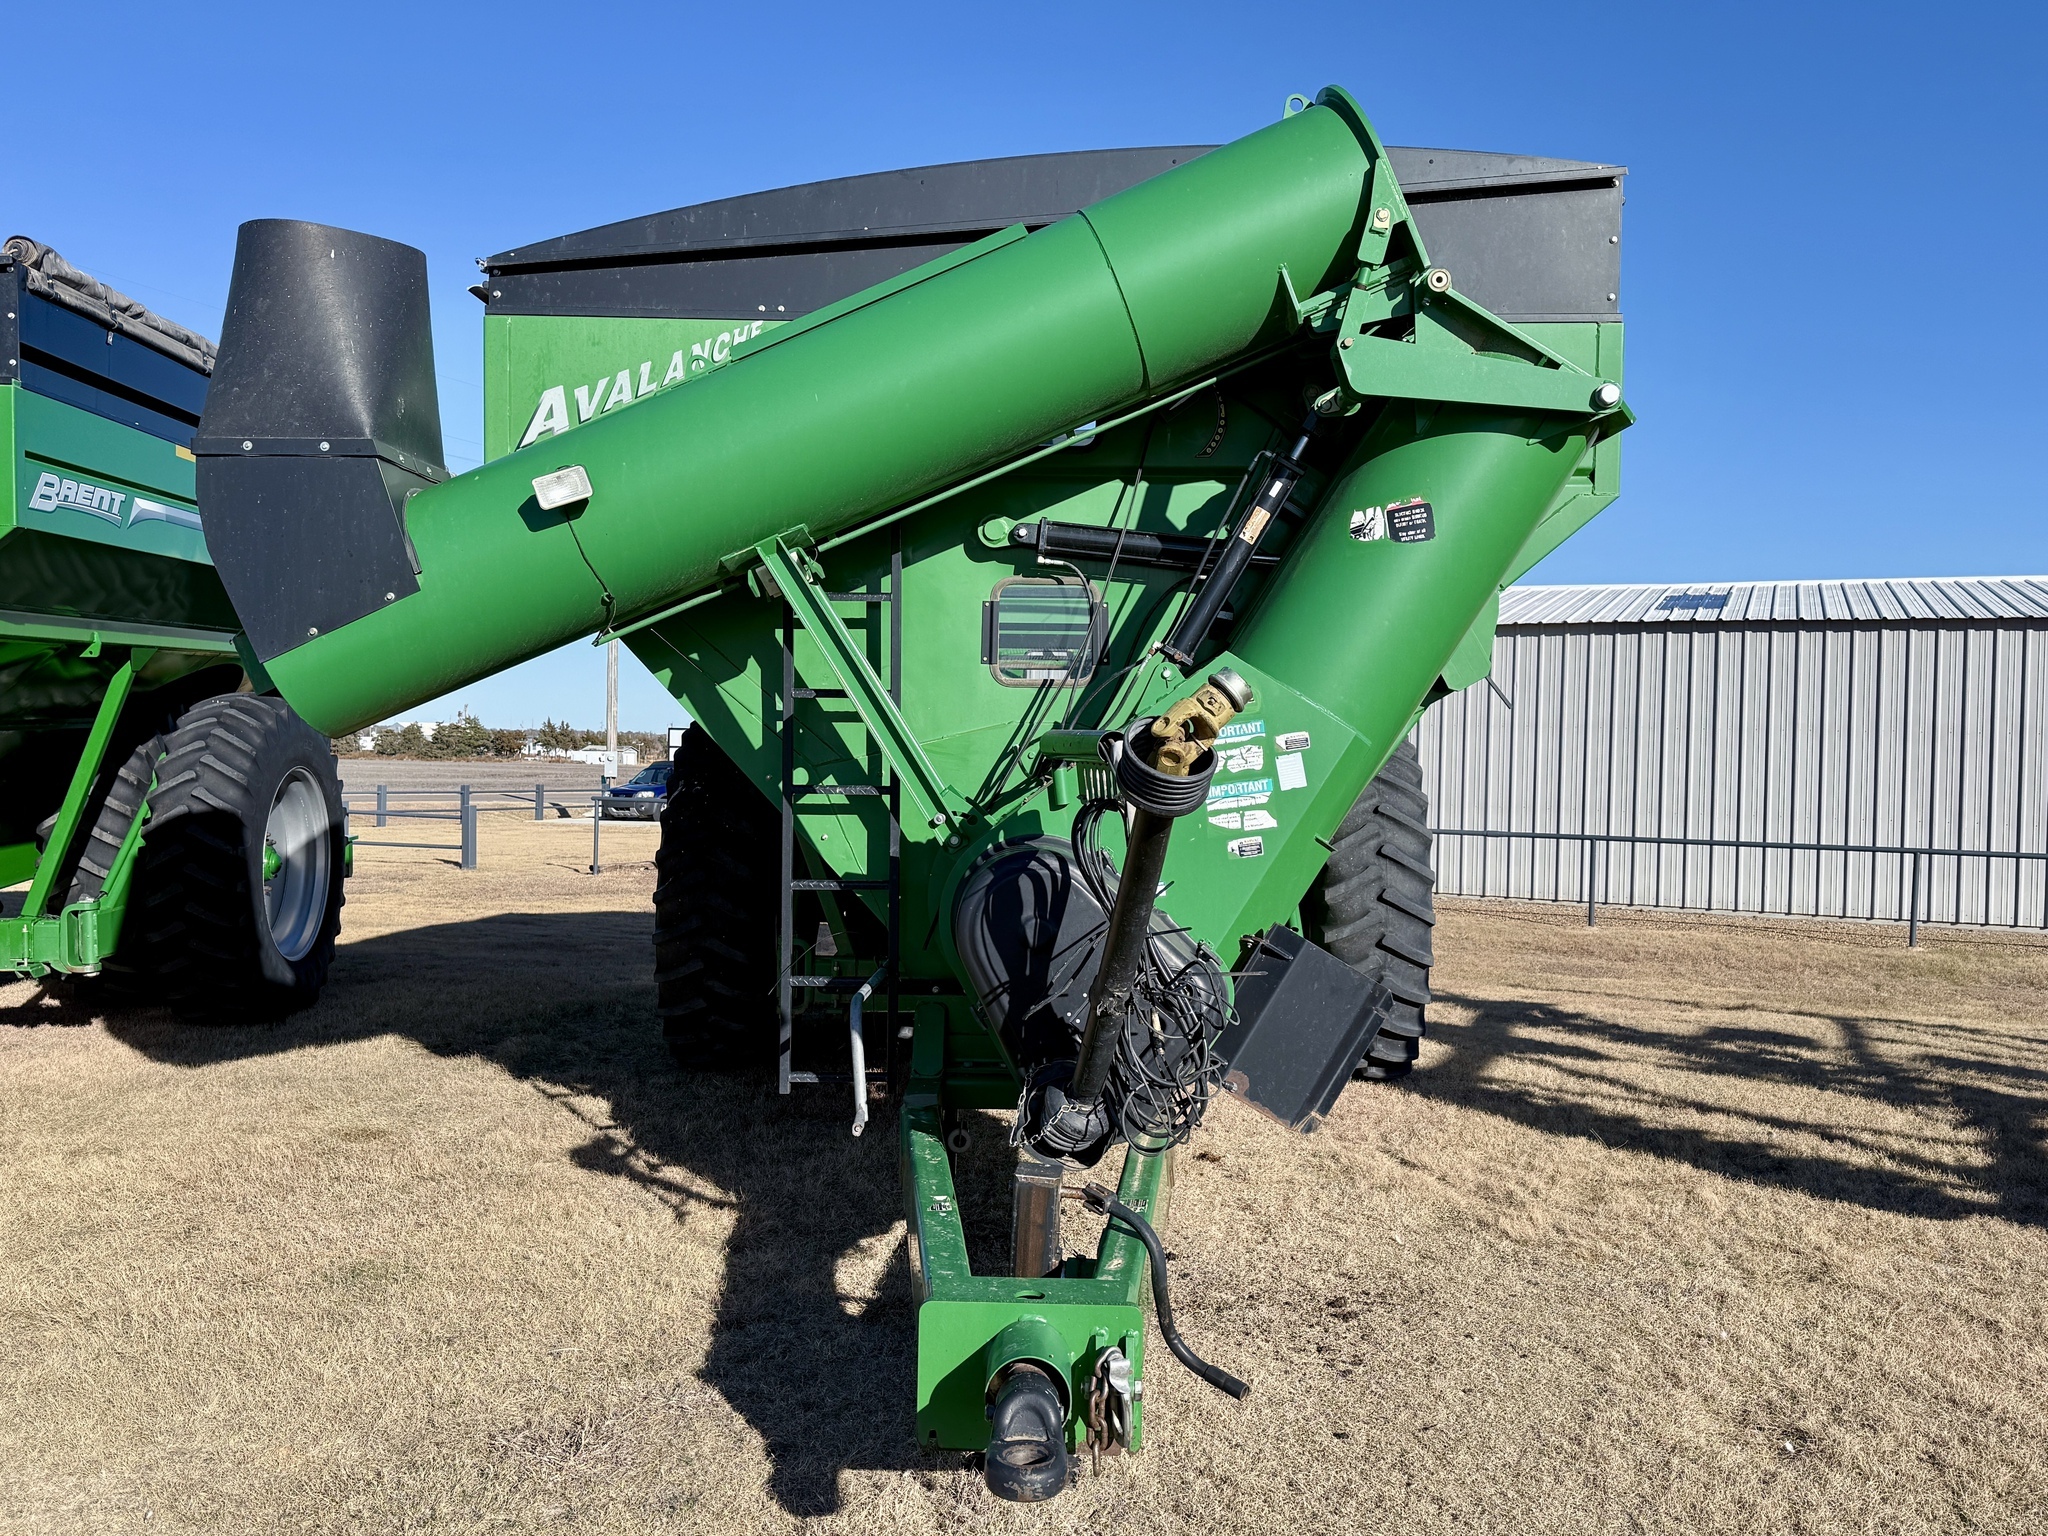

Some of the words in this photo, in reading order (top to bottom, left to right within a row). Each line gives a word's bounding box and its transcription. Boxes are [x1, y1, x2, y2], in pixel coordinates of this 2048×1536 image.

[515, 320, 763, 451] AVALANCHE
[28, 471, 126, 514] BRENT
[1218, 721, 1263, 738] ORTANT
[1208, 780, 1268, 797] IMPORTANT
